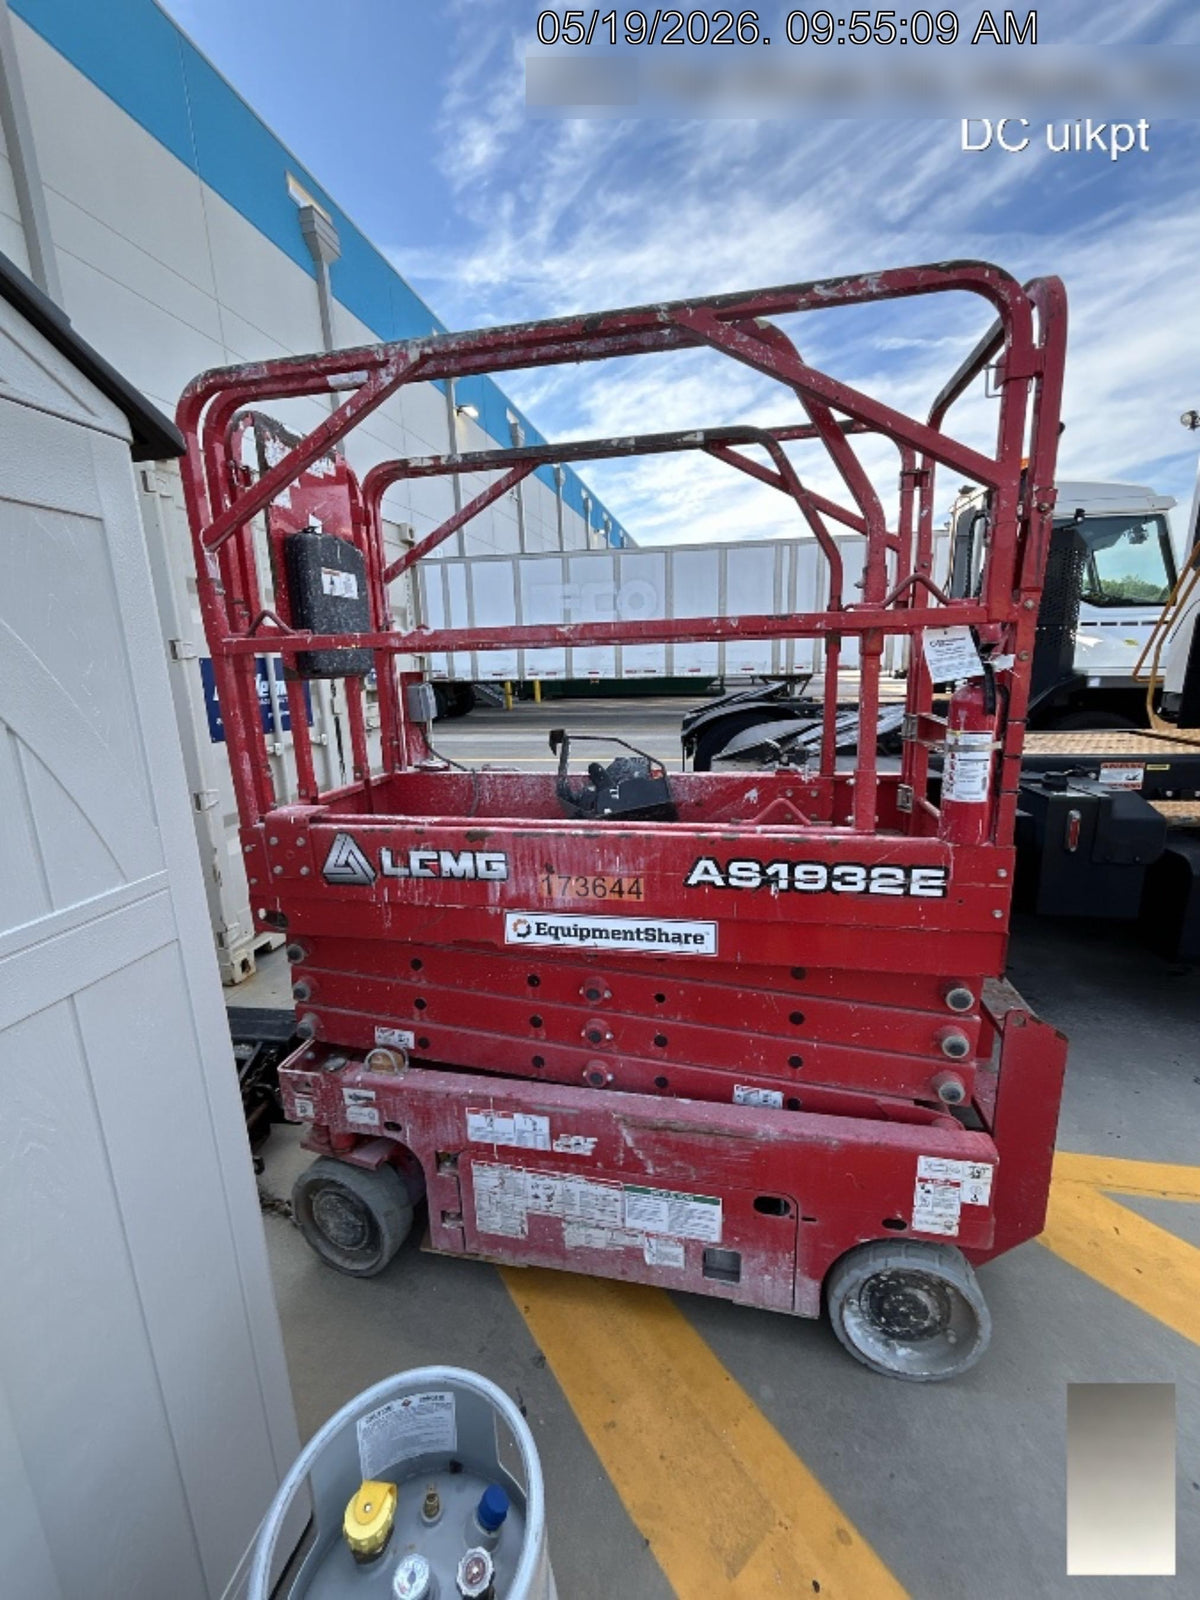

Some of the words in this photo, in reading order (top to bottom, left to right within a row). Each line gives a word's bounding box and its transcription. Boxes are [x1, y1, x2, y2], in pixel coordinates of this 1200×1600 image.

[541, 875, 643, 900] 173644
[684, 857, 949, 897] AS1932E
[535, 922, 706, 945] EquipmentShare
